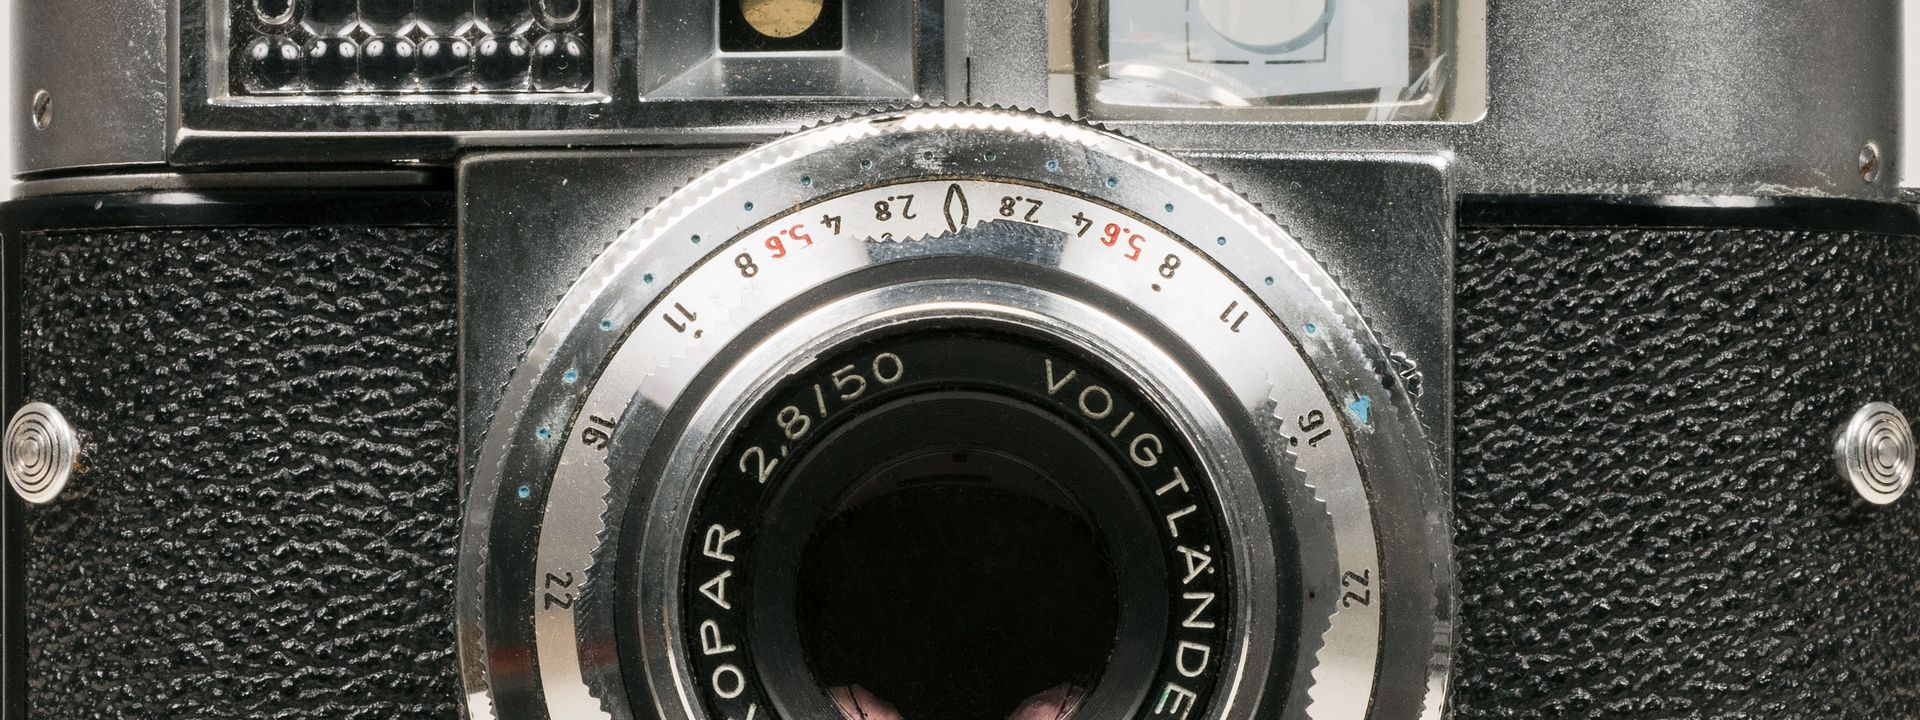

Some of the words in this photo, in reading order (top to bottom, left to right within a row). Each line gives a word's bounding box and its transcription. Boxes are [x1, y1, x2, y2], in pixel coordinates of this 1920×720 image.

[874, 194, 917, 221] 2.8
[999, 195, 1043, 223] 2.8
[820, 214, 842, 235] 4
[1072, 211, 1094, 238] 4
[765, 224, 813, 259] 5.6
[1100, 223, 1146, 261] 5.6
[734, 252, 758, 278] 8
[1158, 253, 1181, 279] 8
[662, 302, 697, 333] 11
[1219, 300, 1249, 333] 11
[581, 414, 617, 451] 16
[739, 352, 904, 484] 2,8/50
[1297, 409, 1332, 448] 16
[544, 571, 573, 610] 22
[1341, 568, 1371, 608] 22
